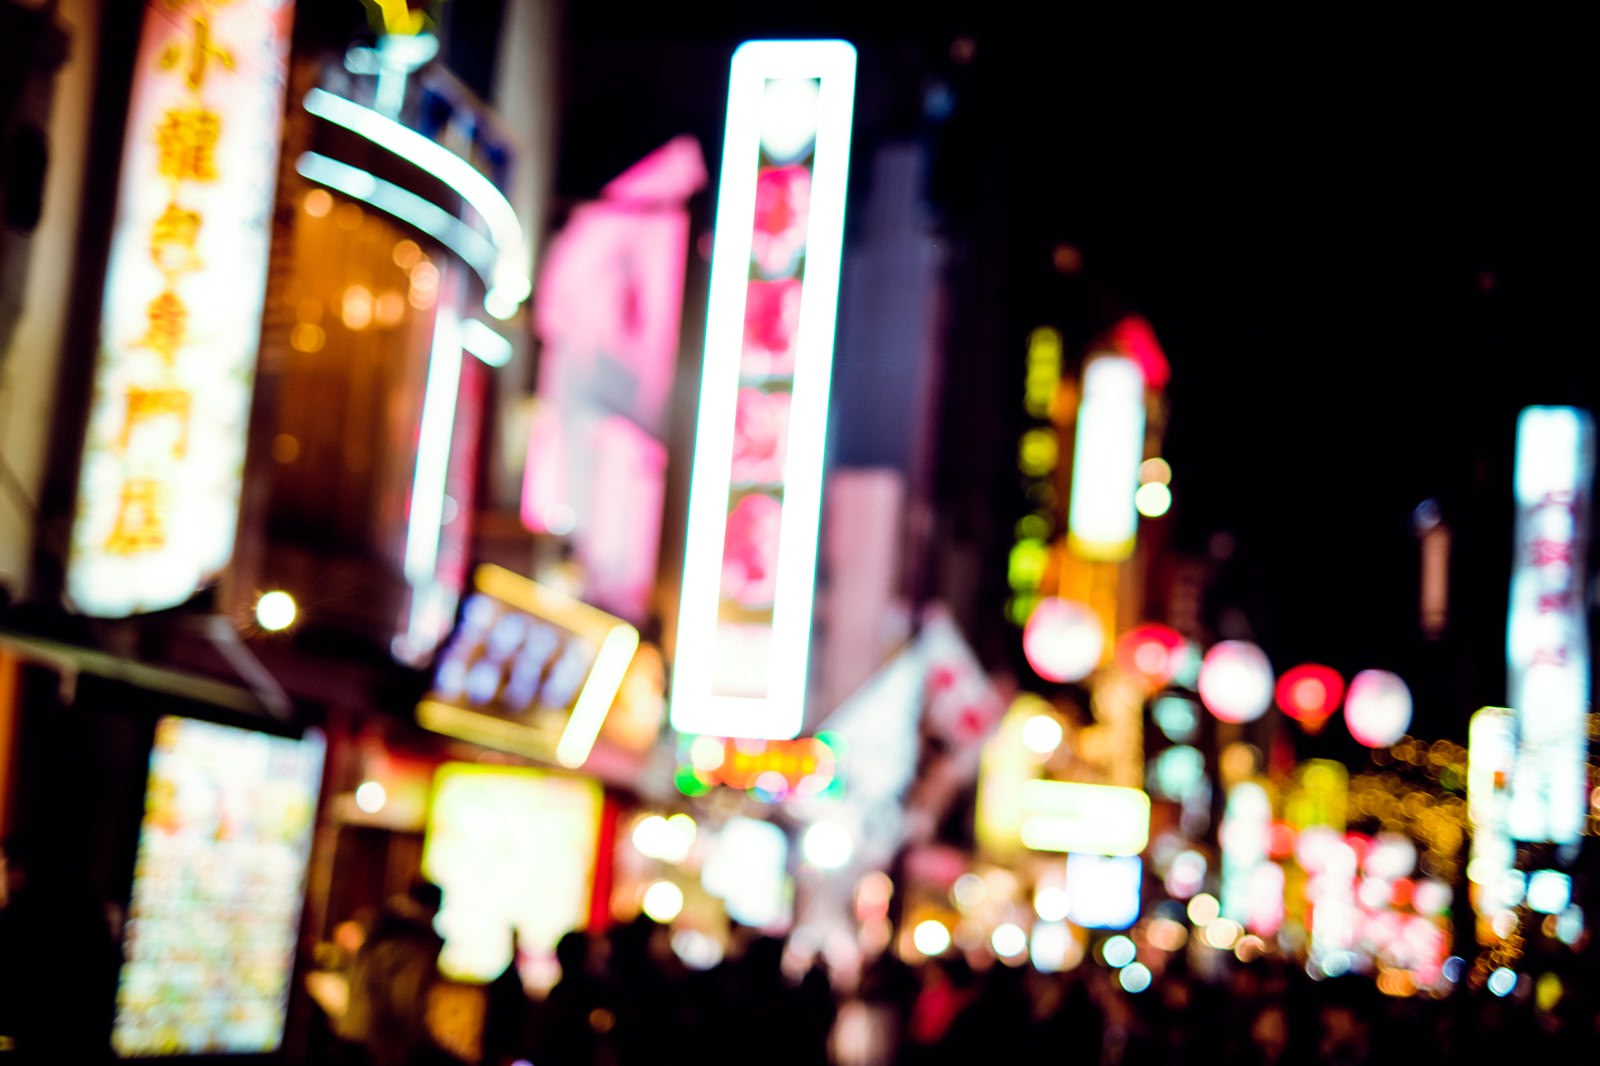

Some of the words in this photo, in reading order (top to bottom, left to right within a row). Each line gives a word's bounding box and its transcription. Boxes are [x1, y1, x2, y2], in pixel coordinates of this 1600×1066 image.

[104, 0, 236, 557] 小籠包専門店
